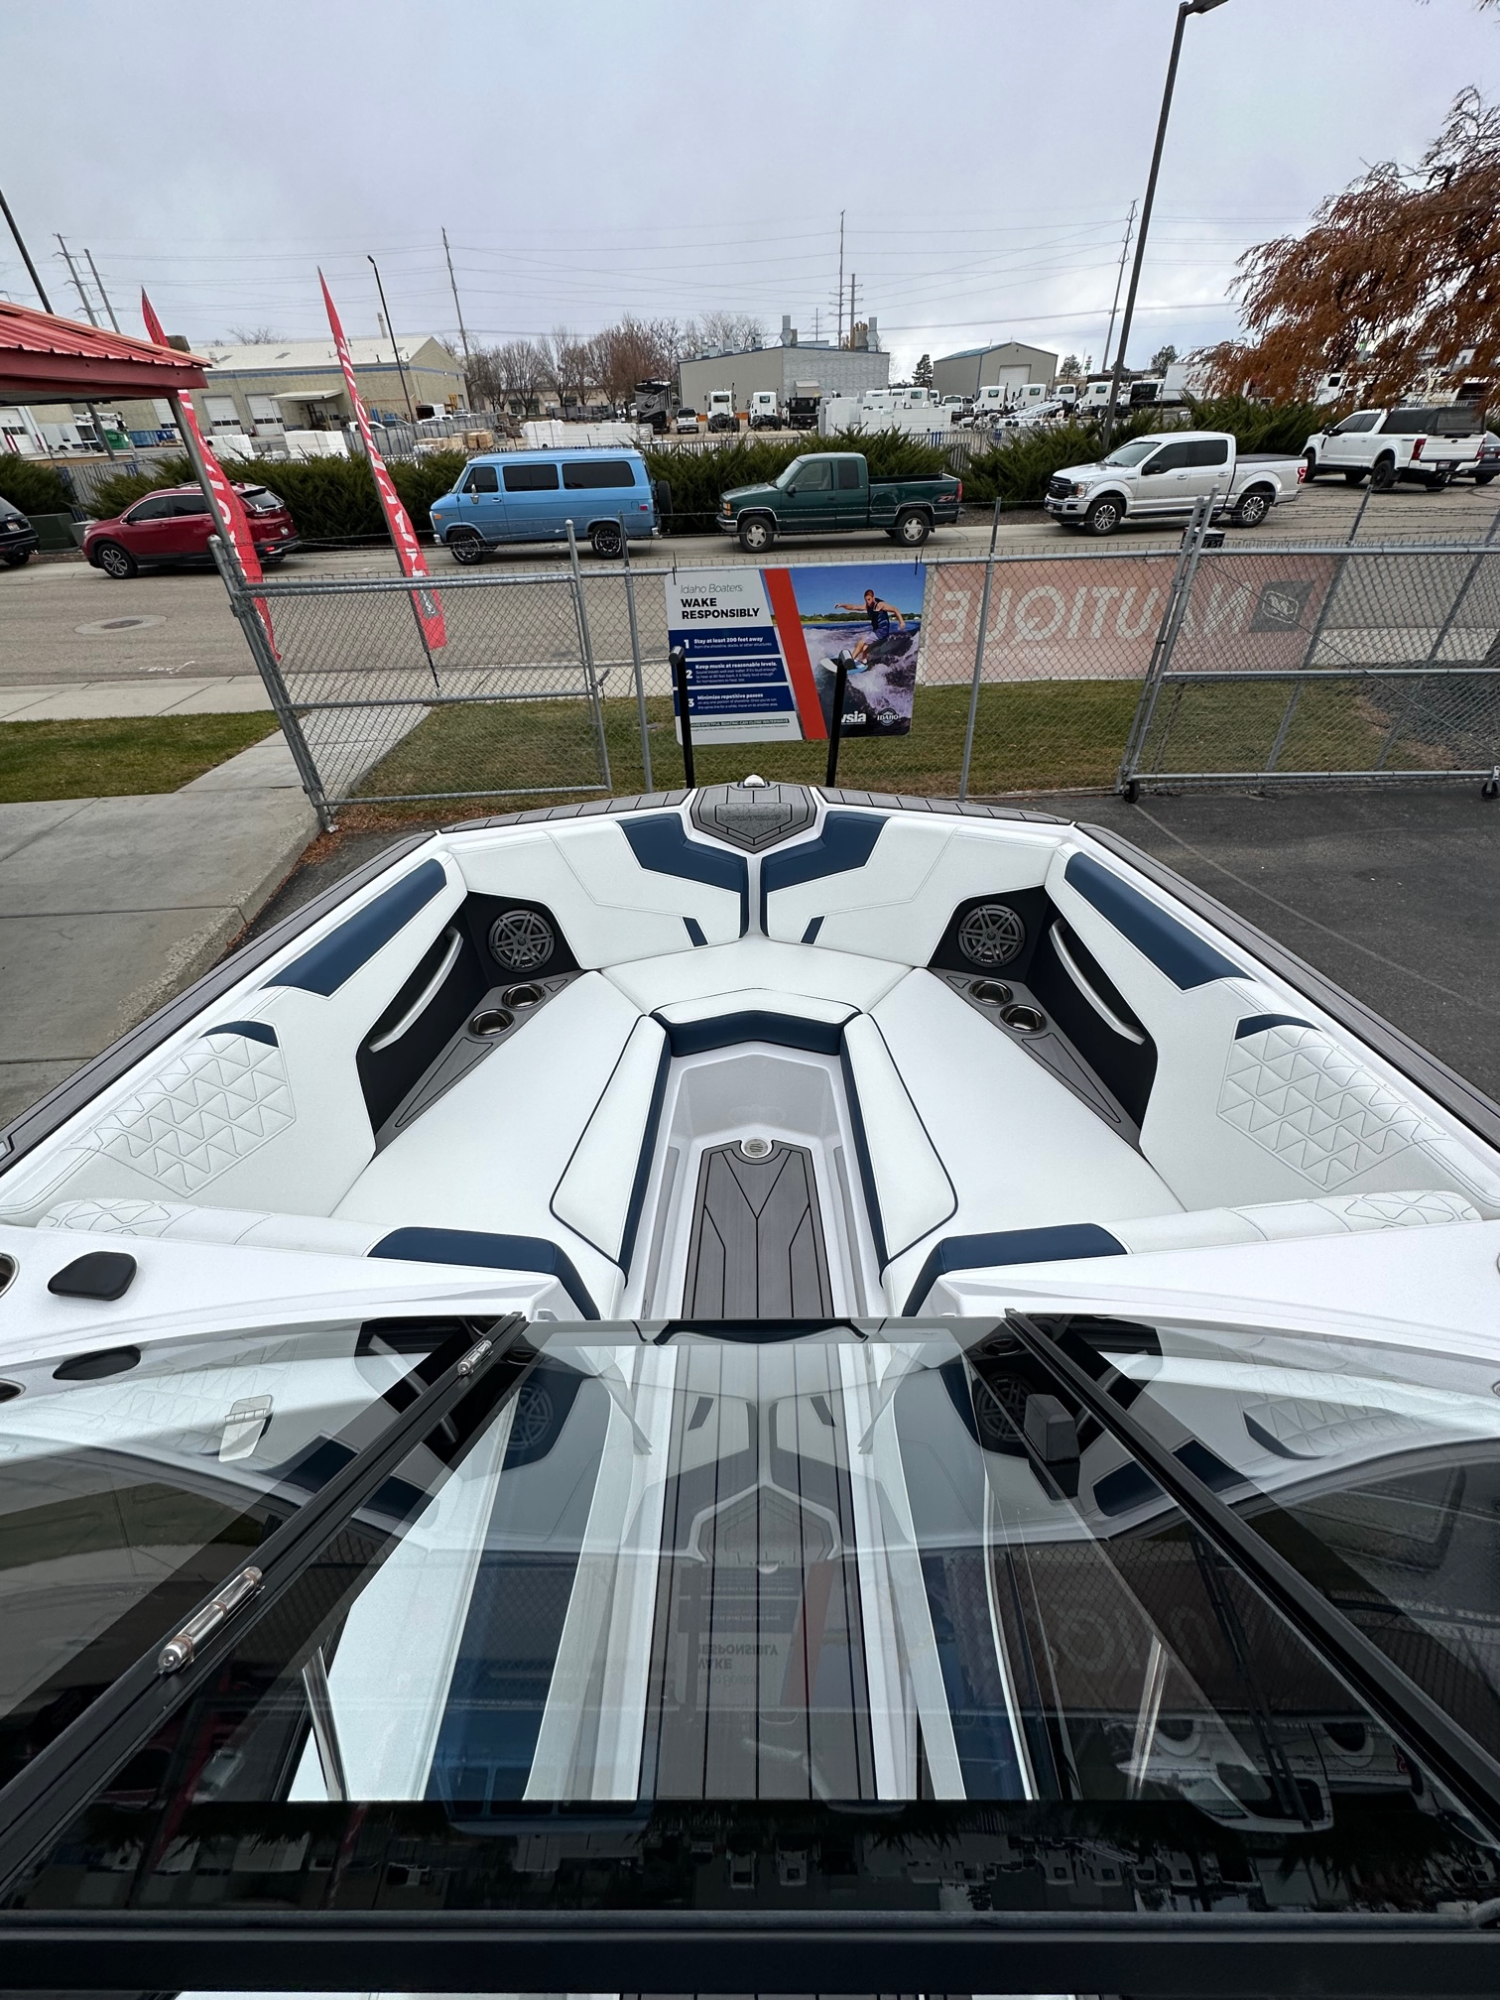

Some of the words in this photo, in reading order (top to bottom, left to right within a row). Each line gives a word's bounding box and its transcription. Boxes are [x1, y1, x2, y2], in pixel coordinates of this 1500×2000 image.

[680, 584, 707, 594] Idaho
[680, 597, 718, 608] WAKE
[681, 607, 760, 620] RESPONSIBLY
[683, 639, 690, 649] 1
[685, 669, 693, 679] 2
[688, 698, 695, 708] 3
